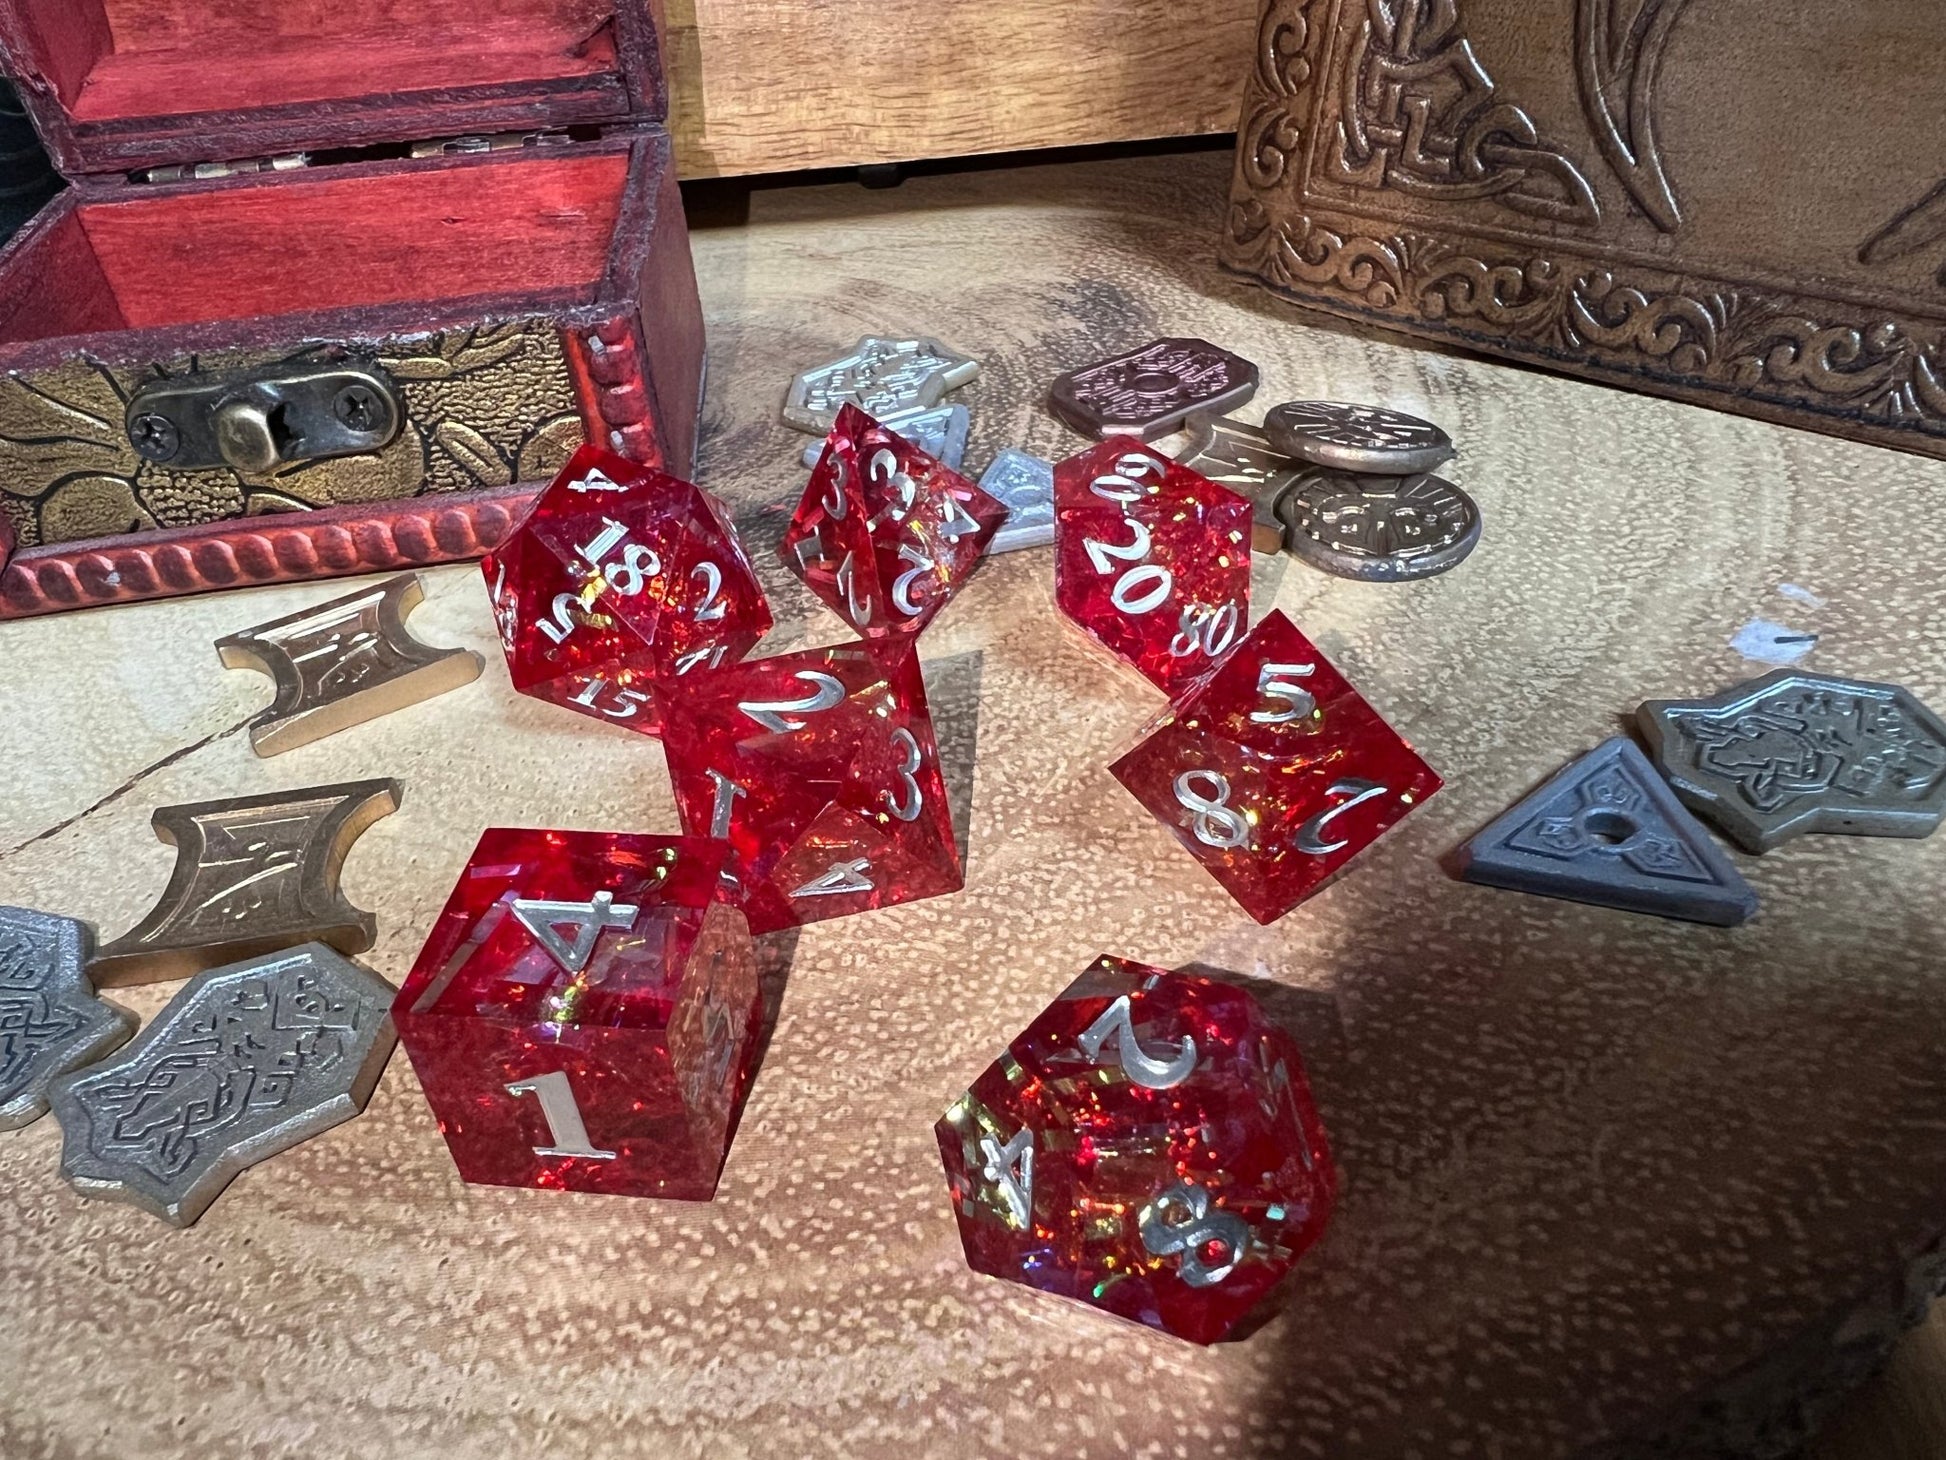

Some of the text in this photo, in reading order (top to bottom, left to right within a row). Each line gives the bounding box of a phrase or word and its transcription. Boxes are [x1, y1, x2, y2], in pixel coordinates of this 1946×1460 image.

[574, 515, 662, 596] 18
[691, 561, 728, 623] 2
[1082, 518, 1171, 614] 20
[1169, 599, 1238, 658] 80
[567, 677, 652, 719] 15
[737, 670, 846, 735] 2
[1250, 663, 1317, 724] 5
[889, 726, 924, 823] 3
[1172, 769, 1250, 848] 8
[510, 890, 641, 976] 4
[503, 1070, 617, 1160] 1
[1138, 1181, 1250, 1288] 8
